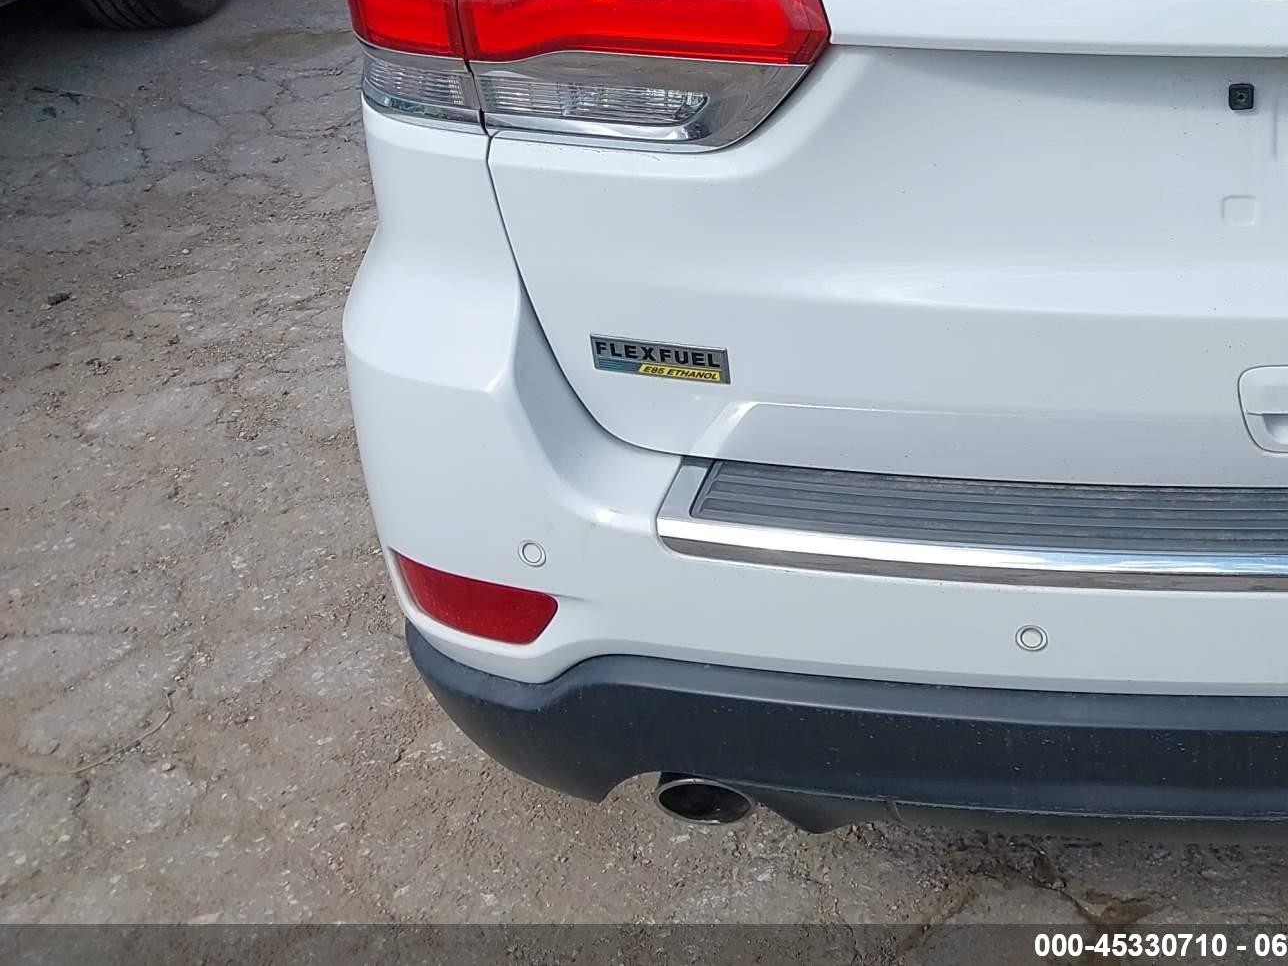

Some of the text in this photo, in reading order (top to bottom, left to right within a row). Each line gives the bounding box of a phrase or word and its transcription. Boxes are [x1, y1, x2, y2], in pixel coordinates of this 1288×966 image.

[595, 341, 721, 368] FLEXFUEL
[643, 365, 718, 380] E85 ETHANOL
